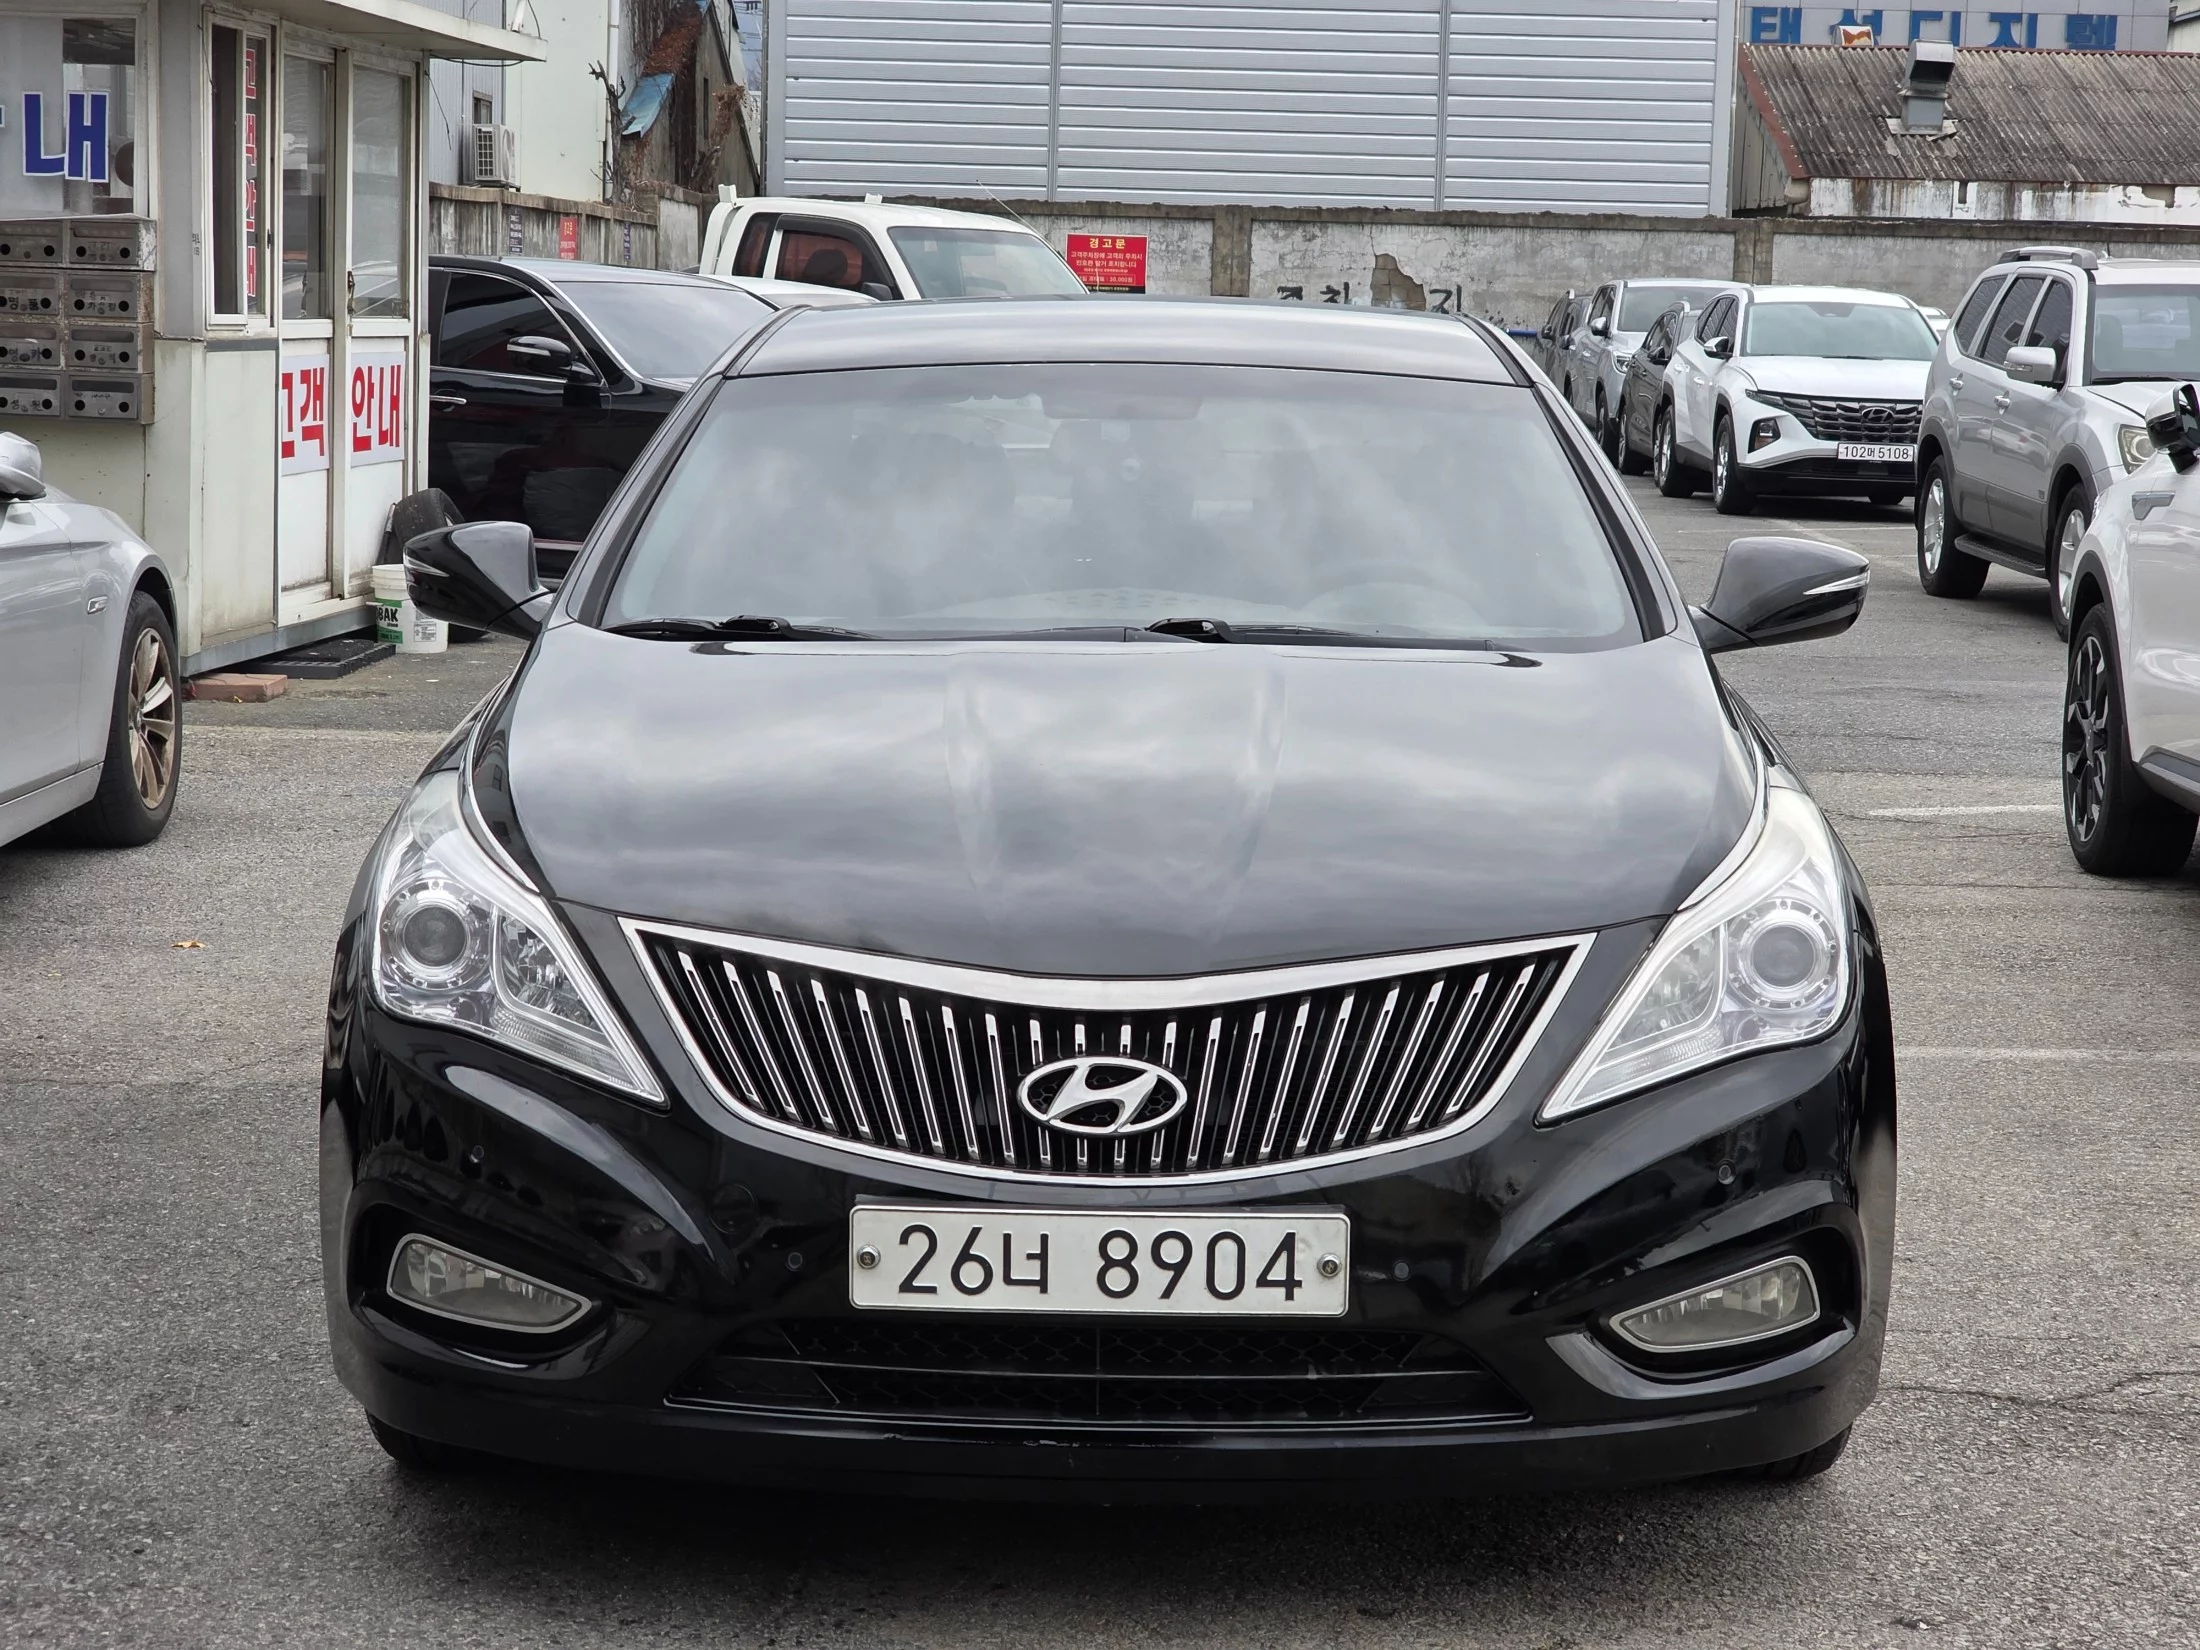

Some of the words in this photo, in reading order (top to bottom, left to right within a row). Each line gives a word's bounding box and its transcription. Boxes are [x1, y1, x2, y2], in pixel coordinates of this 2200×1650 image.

[1090, 238, 1125, 249] 경고문
[351, 364, 401, 453] 안내
[1878, 447, 1909, 460] 5108
[376, 607, 398, 622] BAK
[898, 1224, 1048, 1296] 26너
[1097, 1229, 1302, 1301] 8904
